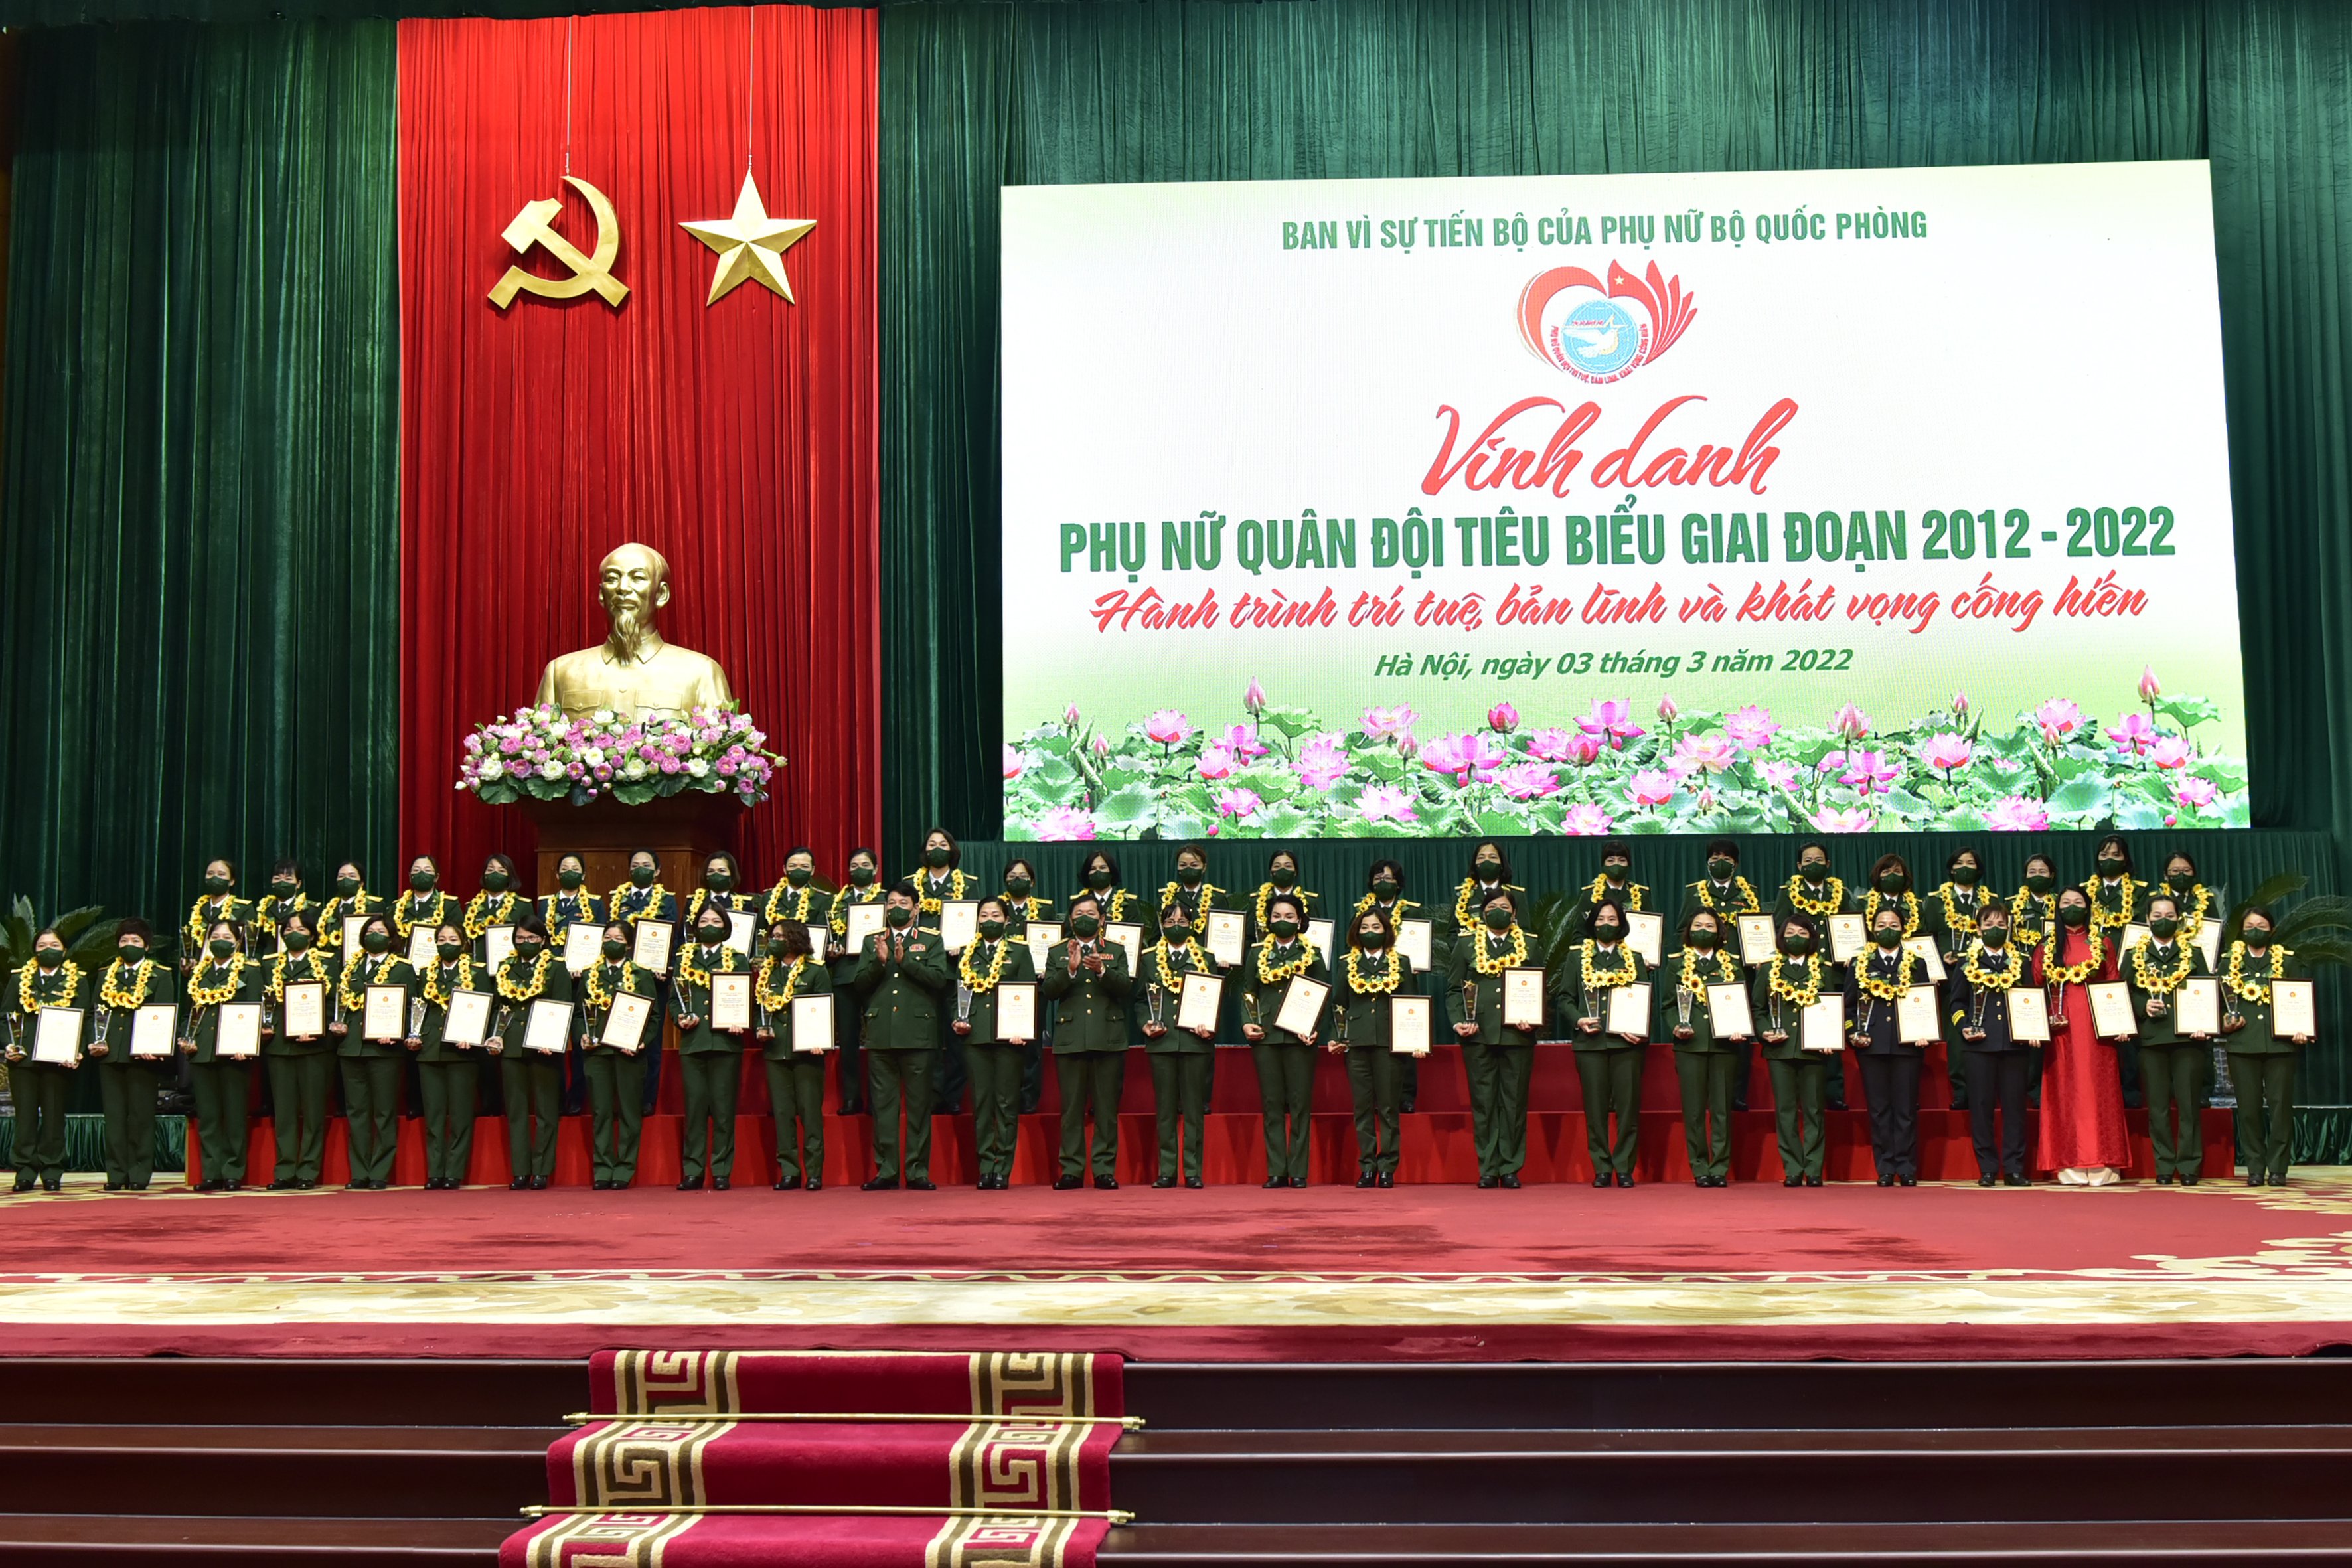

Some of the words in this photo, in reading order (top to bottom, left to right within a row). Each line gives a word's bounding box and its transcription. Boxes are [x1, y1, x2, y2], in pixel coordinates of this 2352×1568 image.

[1283, 221, 1337, 249] BAN
[1346, 215, 1370, 248] VÌ
[1381, 217, 1418, 254] SỰ
[1423, 210, 1483, 247] TIẾN
[1494, 212, 1528, 252] BỘ
[1538, 208, 1592, 245] CỦA
[1603, 216, 1654, 250] PHỤ
[1664, 209, 1704, 243] NỮ
[1711, 210, 1745, 248] BỘ
[1757, 204, 1826, 244] QUỐC
[1837, 206, 1926, 239] PHÒNG
[1591, 395, 1799, 495] danh
[1061, 522, 1146, 583] PHỤ
[1162, 510, 1226, 570] NỮ
[1237, 509, 1356, 574] QUÂN
[1371, 507, 1444, 578] ĐỘI
[1455, 506, 1549, 566] TIÊU
[1567, 494, 1665, 565] BIỂU
[1682, 512, 1769, 563] GIAI
[1784, 510, 1907, 572] ĐOẠN
[1923, 508, 2031, 560] 2012
[2067, 506, 2175, 557] 2022
[1090, 587, 1219, 633] Hành
[1230, 586, 1338, 628] trình
[1348, 586, 1404, 627] trí
[1415, 590, 1485, 631] tuệ,
[1496, 583, 1573, 625] bản
[1583, 582, 1667, 624] lĩnh
[1678, 583, 1727, 623] và
[1737, 578, 1835, 621] khát
[1846, 591, 1940, 633] vọng
[1952, 571, 2043, 632] cống
[2053, 569, 2148, 616] hiến
[1374, 652, 1413, 677] Hà
[1419, 651, 1473, 681] Nội,
[1480, 651, 1552, 680] ngày
[1557, 652, 1594, 674] 03
[1599, 649, 1681, 678] tháng
[1686, 651, 1707, 673] 3
[1711, 649, 1774, 672] năm
[1780, 649, 1853, 672] 2022
